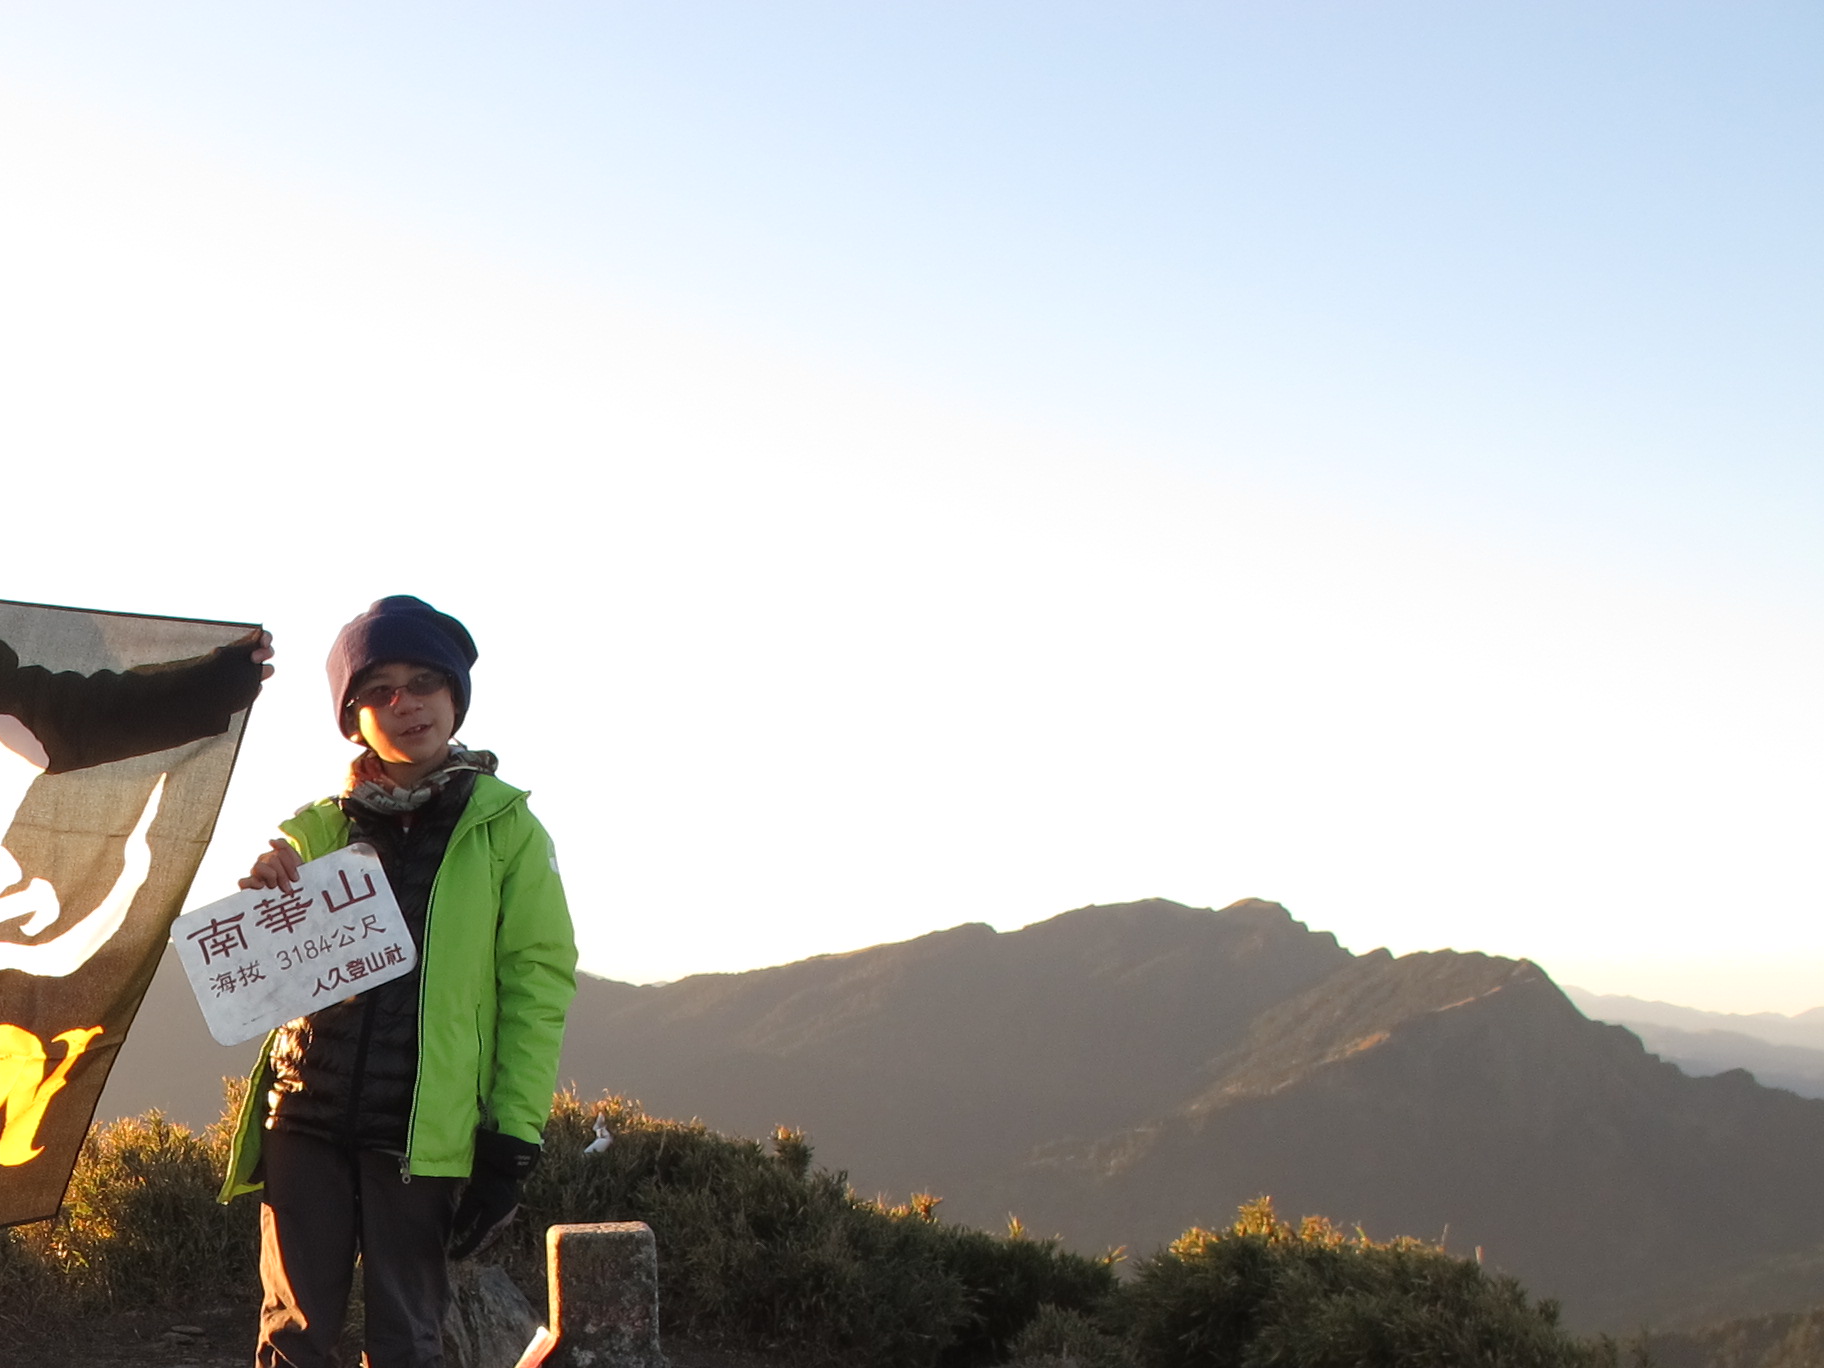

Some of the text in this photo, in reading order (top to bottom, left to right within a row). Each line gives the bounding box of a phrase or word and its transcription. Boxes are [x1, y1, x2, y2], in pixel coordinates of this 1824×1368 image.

[186, 869, 376, 965] 南華山
[208, 913, 387, 999] 海拔 3184公尺
